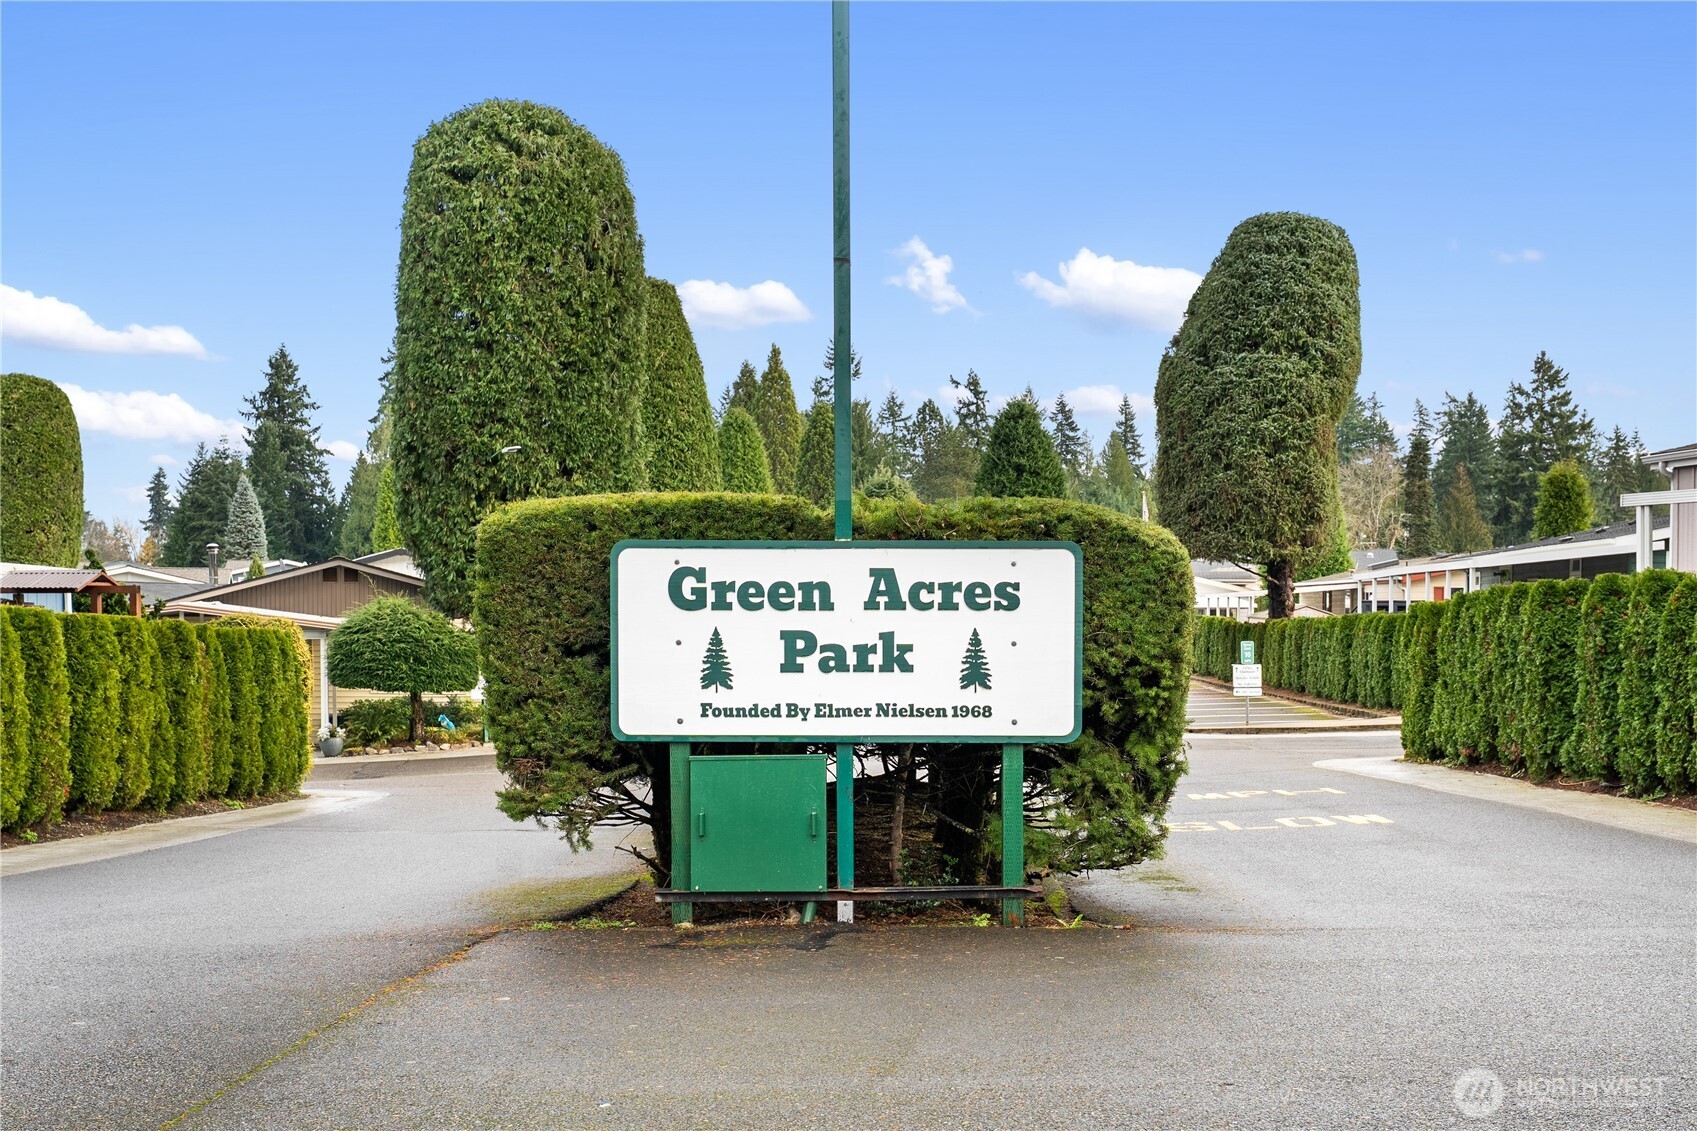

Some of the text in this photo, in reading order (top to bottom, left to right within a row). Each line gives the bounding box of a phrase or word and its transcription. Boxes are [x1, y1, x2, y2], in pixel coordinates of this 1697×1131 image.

[668, 565, 1021, 612] Green Acres
[780, 630, 914, 674] Park
[701, 703, 993, 722] Founded By Elmer Nielsen 1968
[1187, 787, 1346, 800] MPH
[1162, 814, 1395, 832] SLOW
